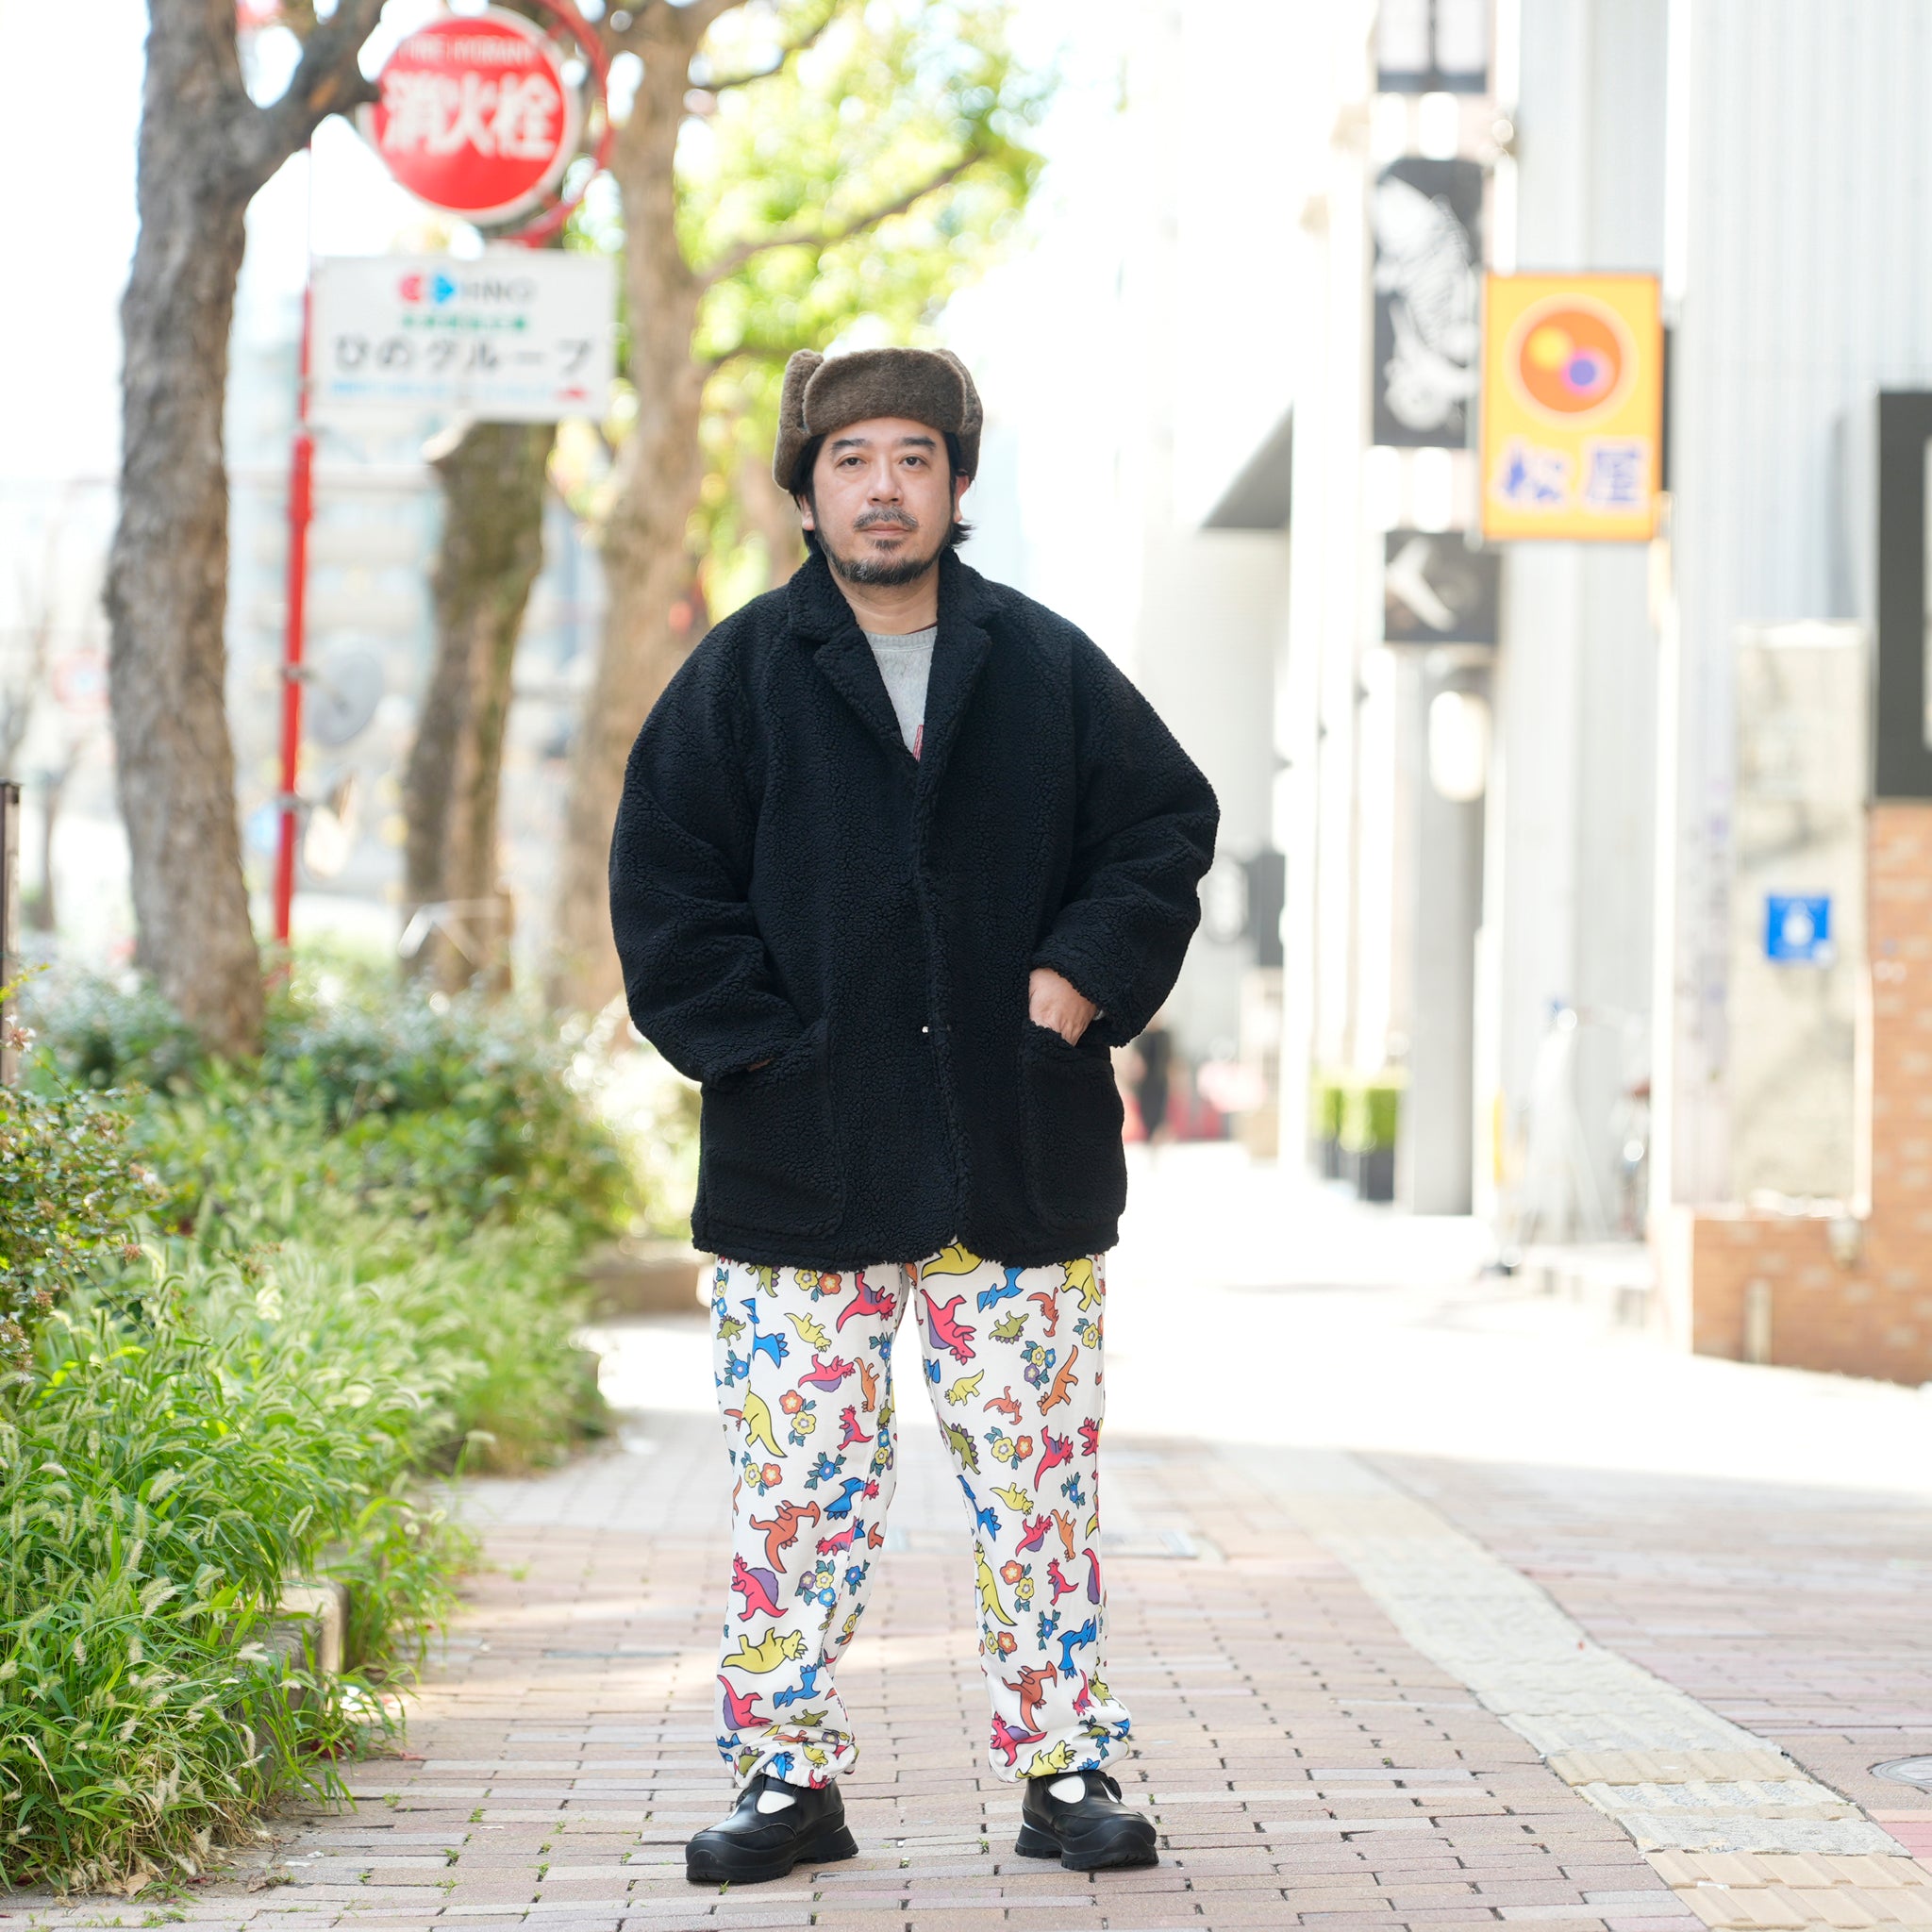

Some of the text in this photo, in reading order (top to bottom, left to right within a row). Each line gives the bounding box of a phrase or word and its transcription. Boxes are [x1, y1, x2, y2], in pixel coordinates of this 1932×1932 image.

[382, 70, 560, 158] 消火栓
[334, 335, 595, 375] ひのグループ
